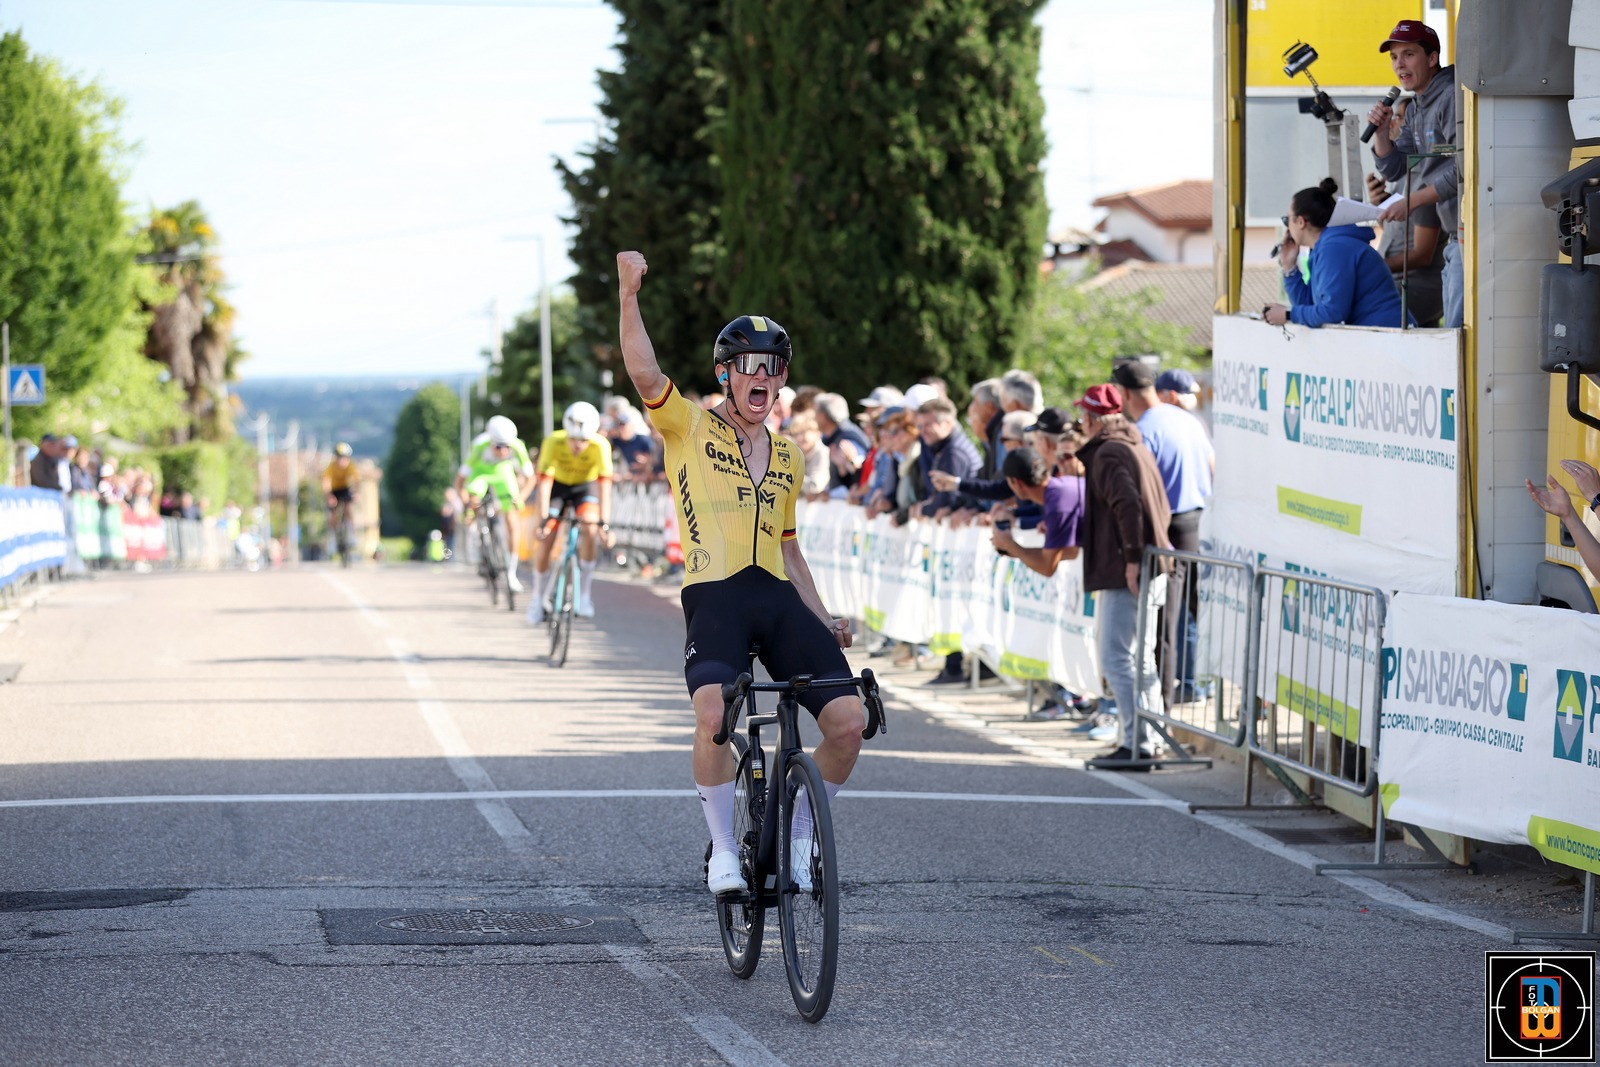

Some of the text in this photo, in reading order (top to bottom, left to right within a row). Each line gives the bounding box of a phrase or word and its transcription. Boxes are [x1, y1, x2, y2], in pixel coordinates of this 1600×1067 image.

[1383, 444, 1405, 461] GRUPPO
[1406, 447, 1425, 464] CASSA
[1426, 450, 1455, 471] CENTRALE
[678, 463, 701, 545] MICHE
[1434, 718, 1462, 738] GRUPPO
[1463, 723, 1487, 743] CASSA
[1488, 728, 1524, 752] CENTRALE
